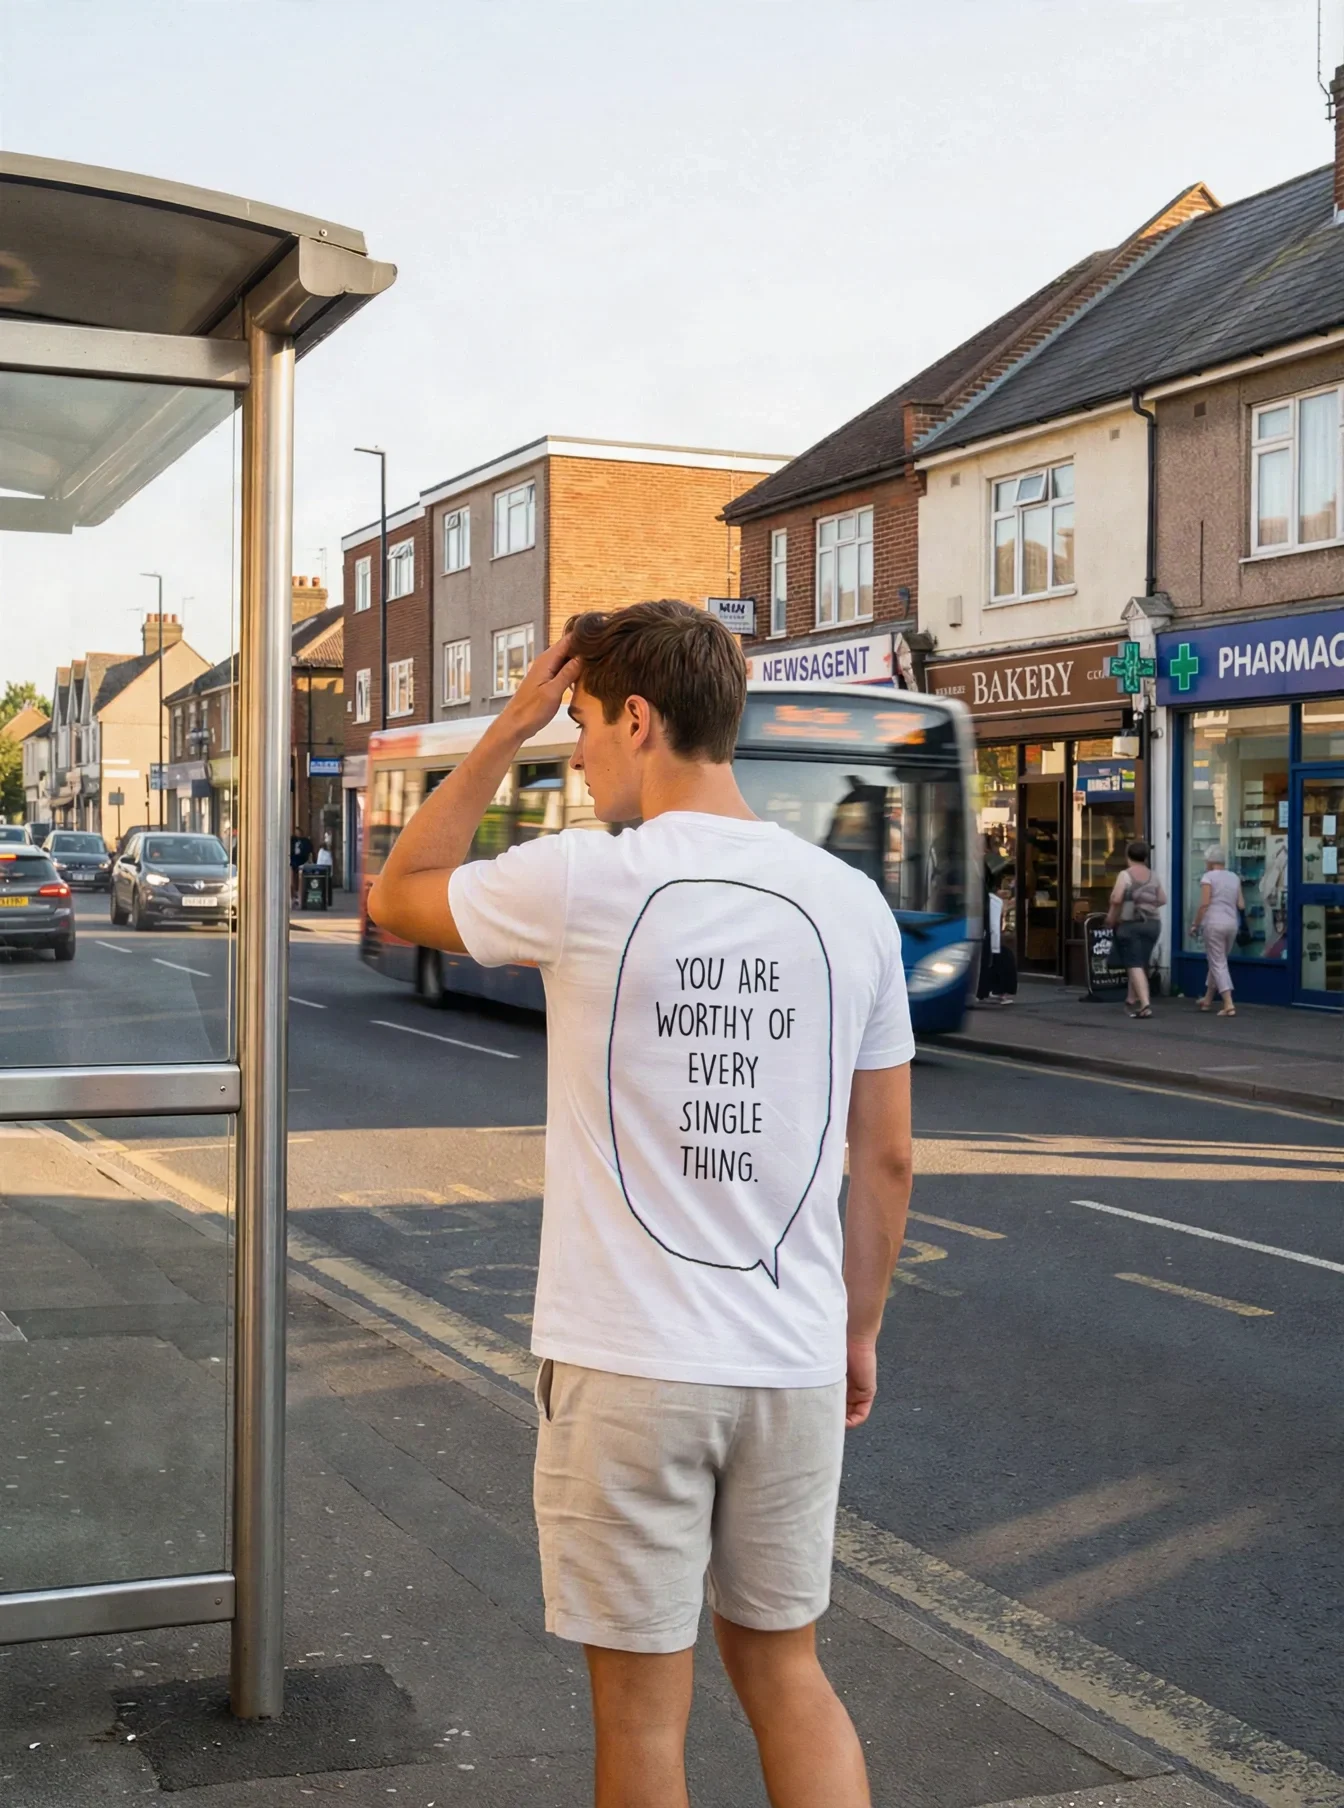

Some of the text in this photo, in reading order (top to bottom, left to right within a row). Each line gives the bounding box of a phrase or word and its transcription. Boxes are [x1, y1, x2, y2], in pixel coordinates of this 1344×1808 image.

[763, 646, 870, 681] NEWSAGENT
[1219, 633, 1344, 678] PHARMAC
[972, 661, 1074, 704] BAKERY
[676, 958, 779, 993] YOU ARE
[656, 1002, 795, 1040] WORTHY OF
[689, 1052, 758, 1088] EVERY
[680, 1100, 762, 1134] SINGLE
[680, 1146, 758, 1182] THING.
